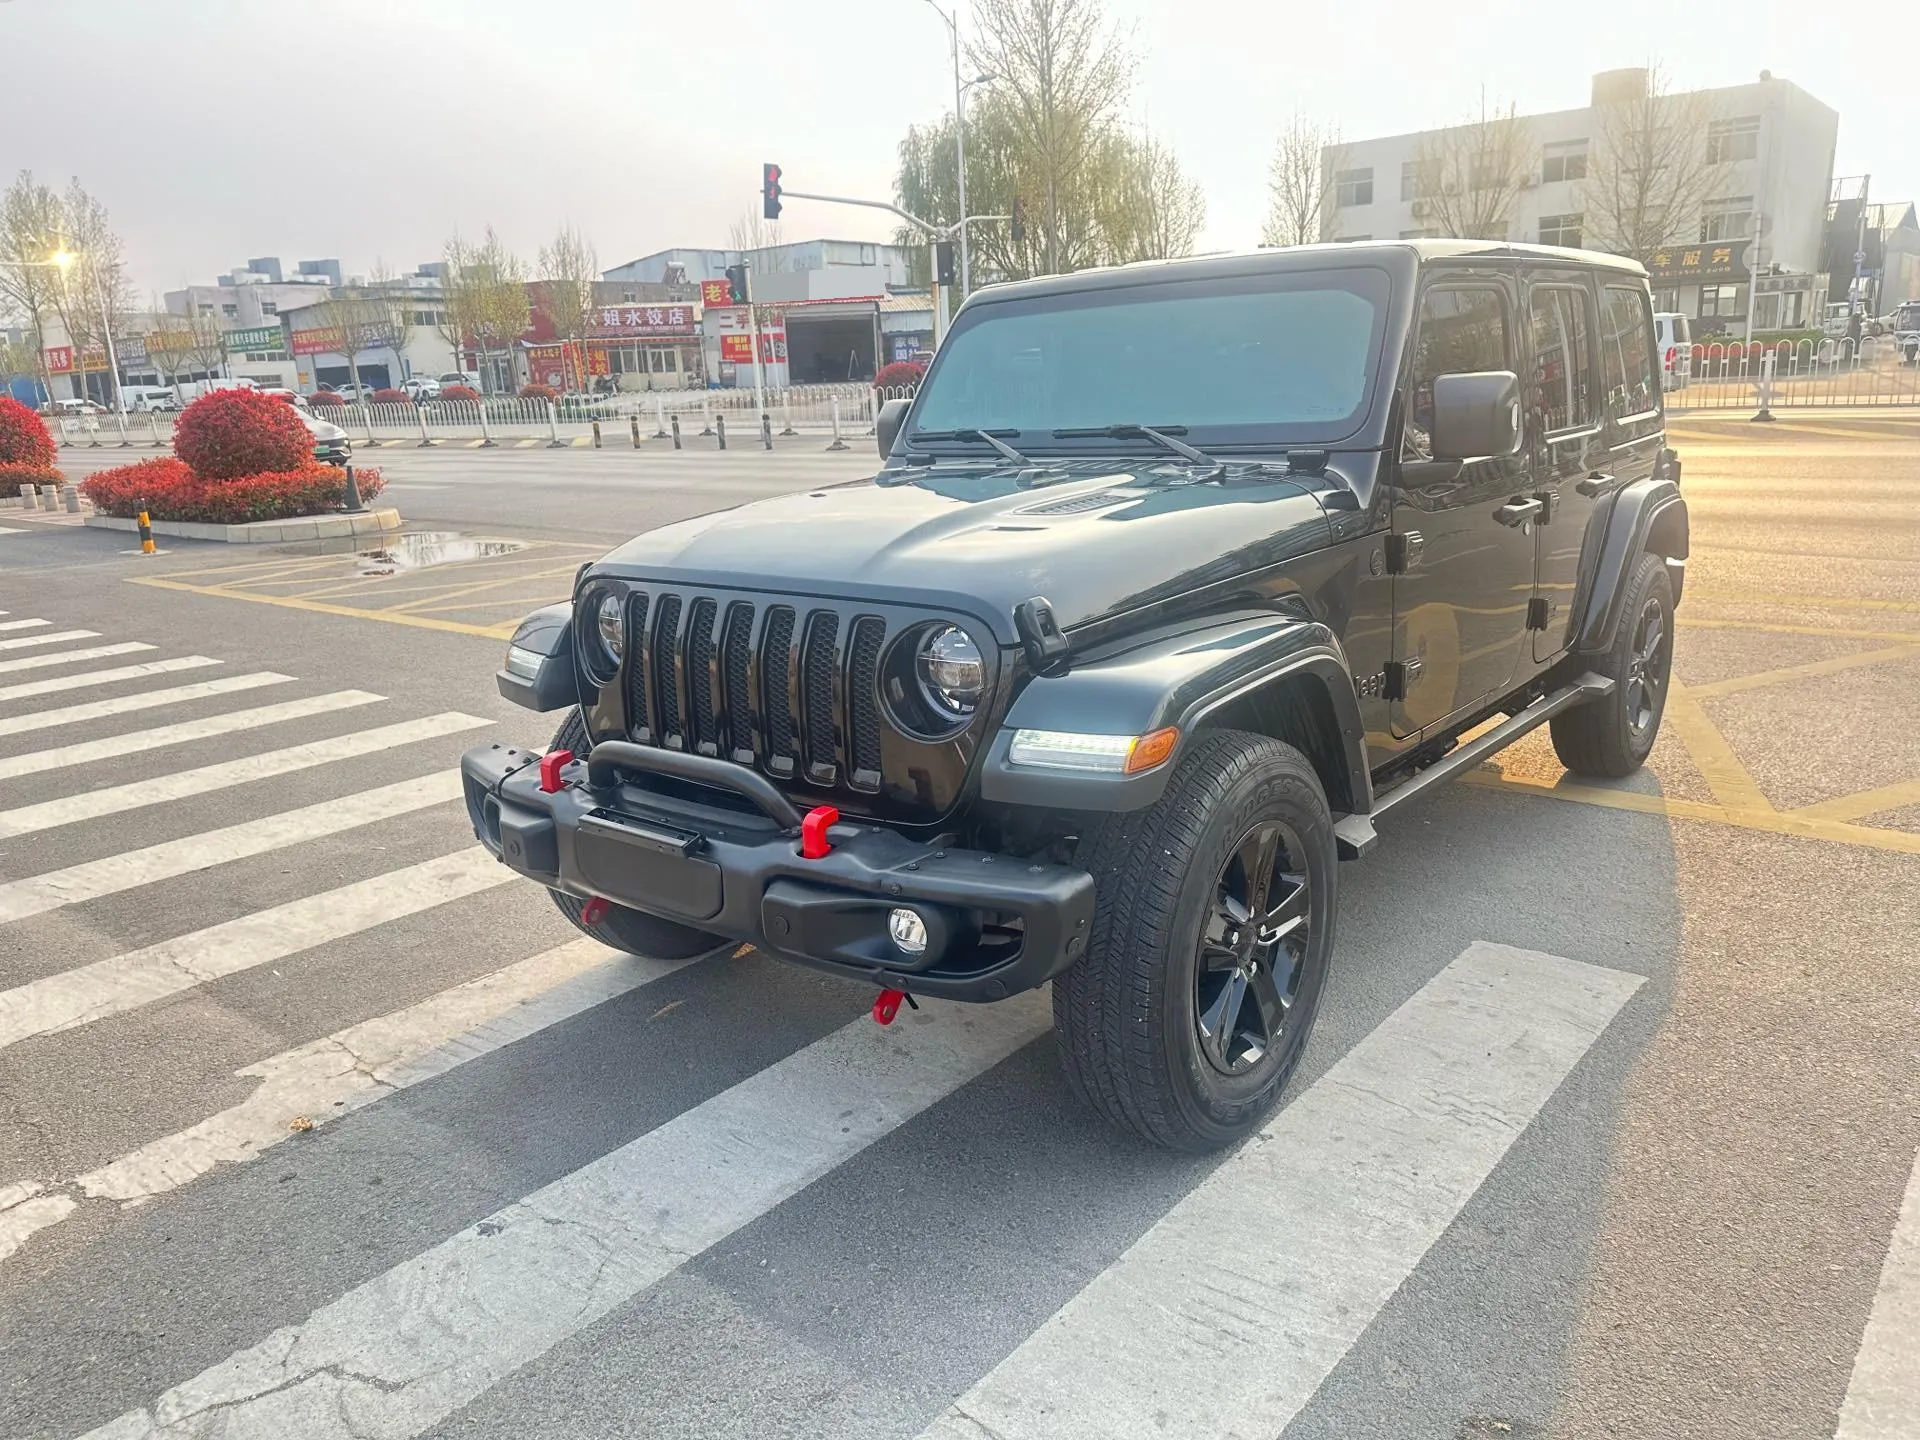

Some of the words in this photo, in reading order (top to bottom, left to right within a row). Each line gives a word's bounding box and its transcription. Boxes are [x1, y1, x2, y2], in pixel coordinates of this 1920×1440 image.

[1653, 247, 1731, 268] 车服务
[1353, 671, 1386, 700] Jeep
